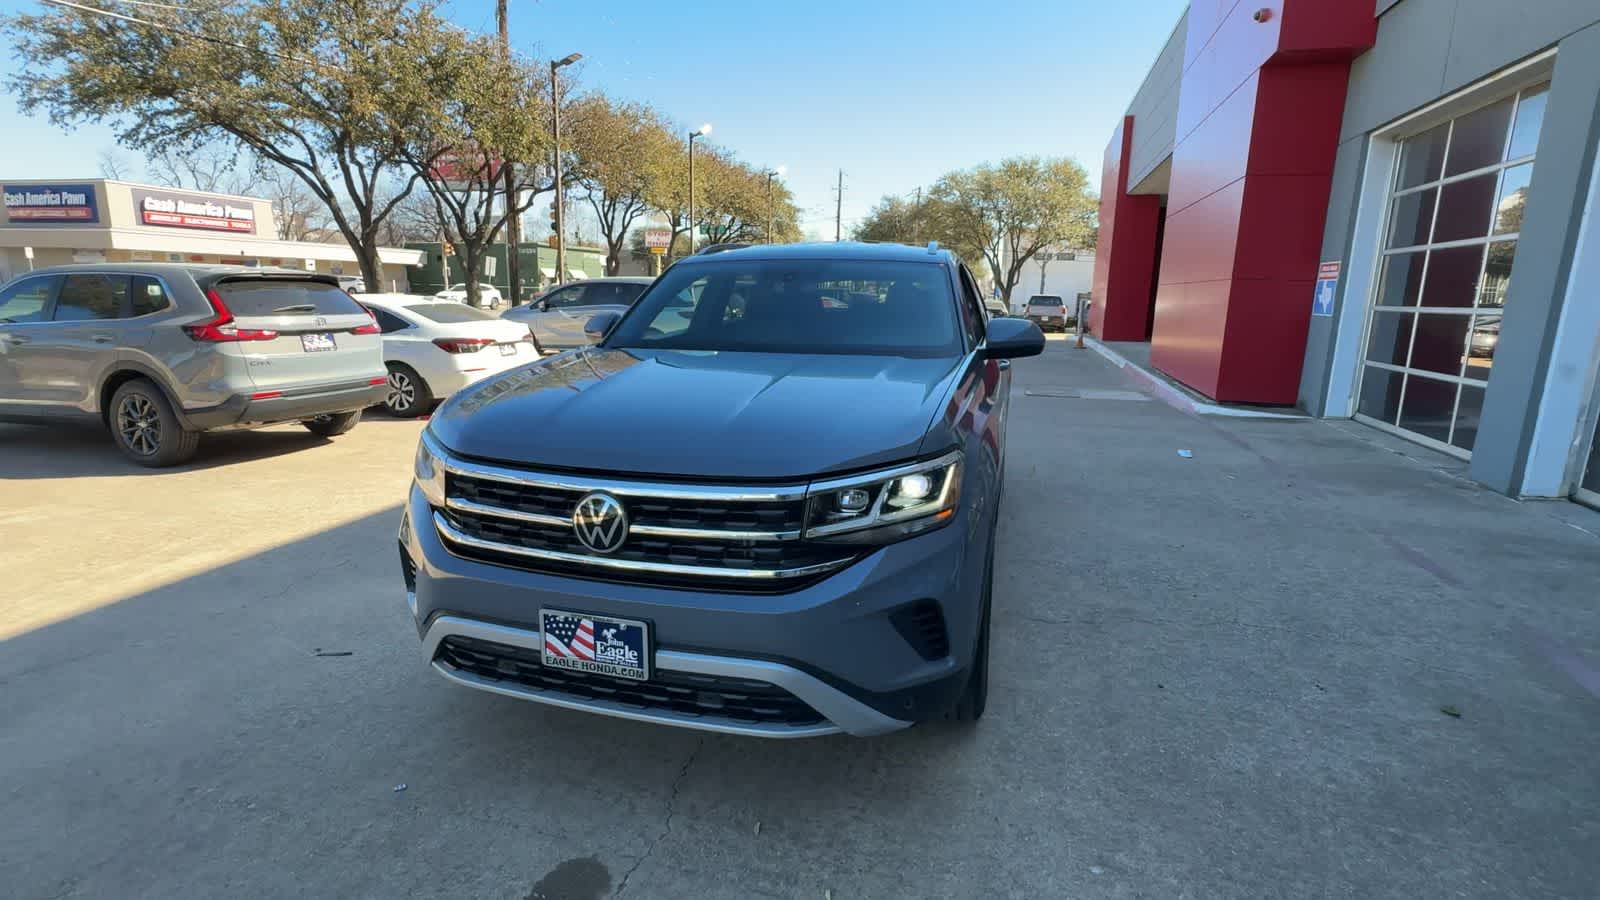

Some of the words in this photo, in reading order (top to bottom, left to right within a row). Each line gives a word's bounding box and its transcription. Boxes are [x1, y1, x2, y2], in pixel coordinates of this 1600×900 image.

[4, 192, 25, 206] Cash
[25, 191, 60, 206] America
[61, 191, 86, 205] Pawn
[144, 196, 176, 212] Cash
[177, 200, 225, 217] America
[225, 205, 254, 220] Pawn
[595, 640, 638, 662] Eagle
[607, 638, 624, 647] John
[545, 655, 578, 669] EAGLE
[581, 660, 645, 679] HONDA.COM
